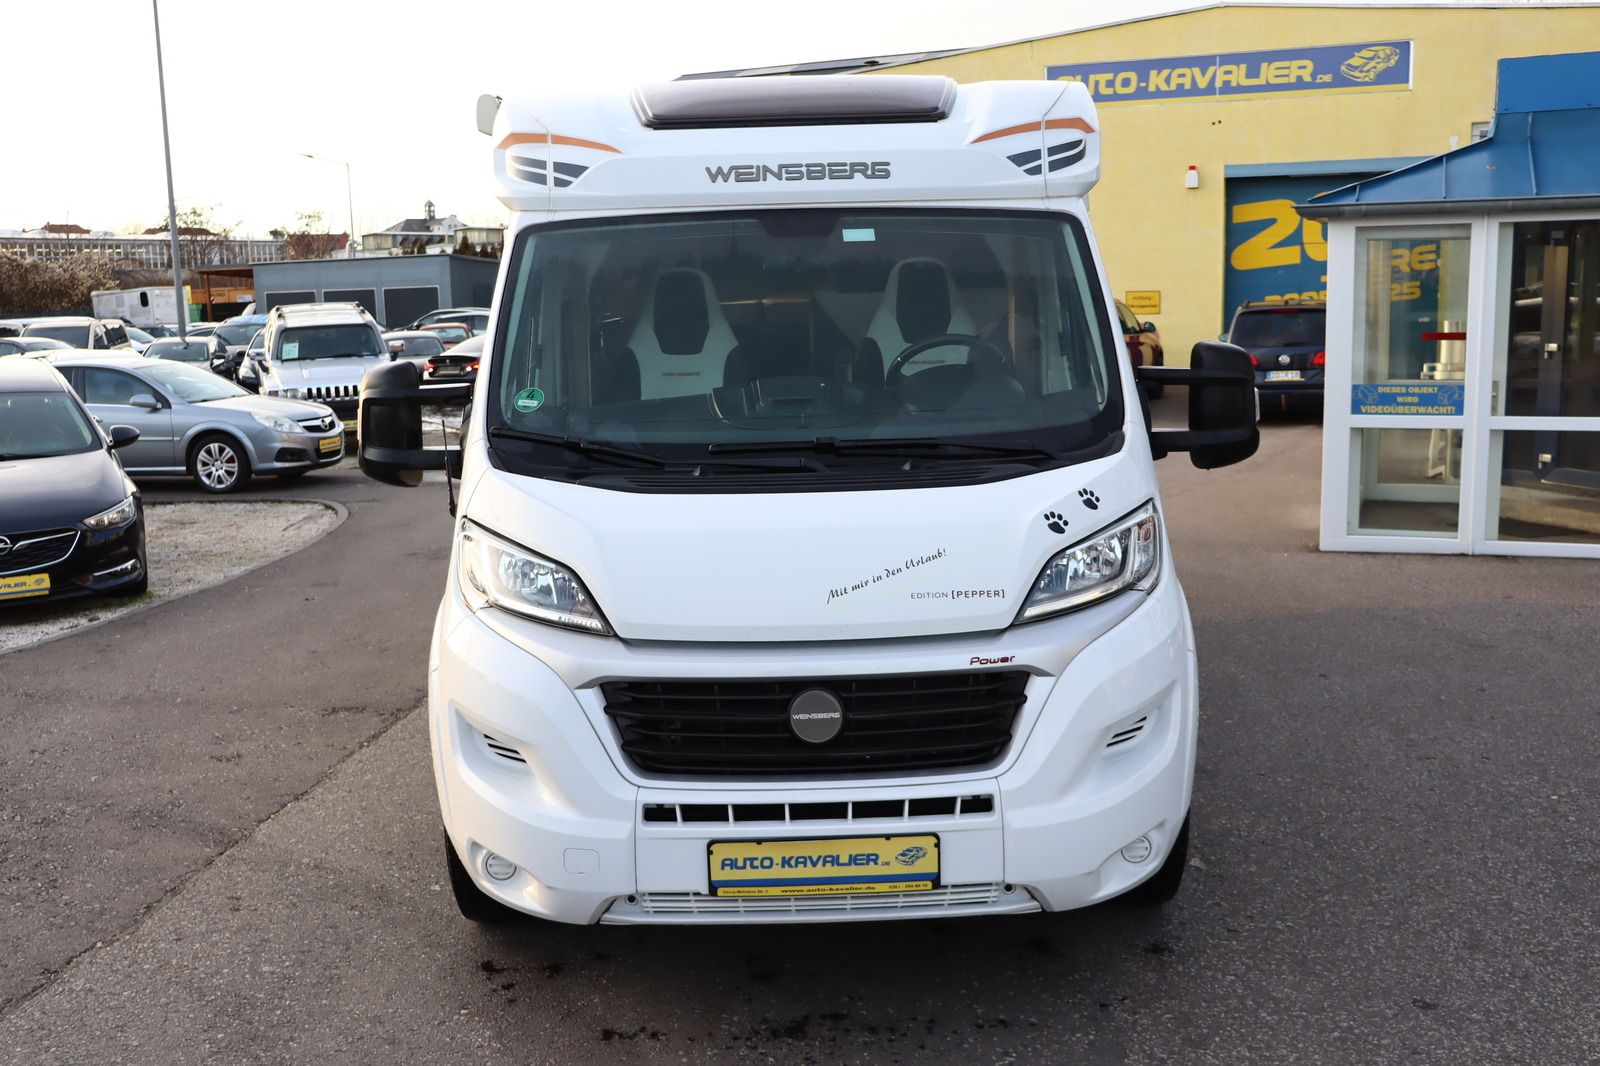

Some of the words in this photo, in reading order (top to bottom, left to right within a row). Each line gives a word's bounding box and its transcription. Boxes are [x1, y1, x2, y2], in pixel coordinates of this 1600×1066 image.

[1056, 60, 1333, 96] UTO-KAVALIER.DE
[705, 162, 891, 184] WEINSBERG
[1360, 403, 1456, 414] VIDEOÜBERWACHT!
[827, 586, 848, 604] Mit
[851, 580, 869, 592] mir
[872, 574, 882, 583] in
[884, 567, 902, 578] den
[905, 548, 947, 570] Urlaub!
[910, 591, 949, 600] EDITION
[951, 589, 1005, 600] [PEPPER]
[970, 655, 1016, 665] Power
[792, 712, 840, 720] WEINSBERG
